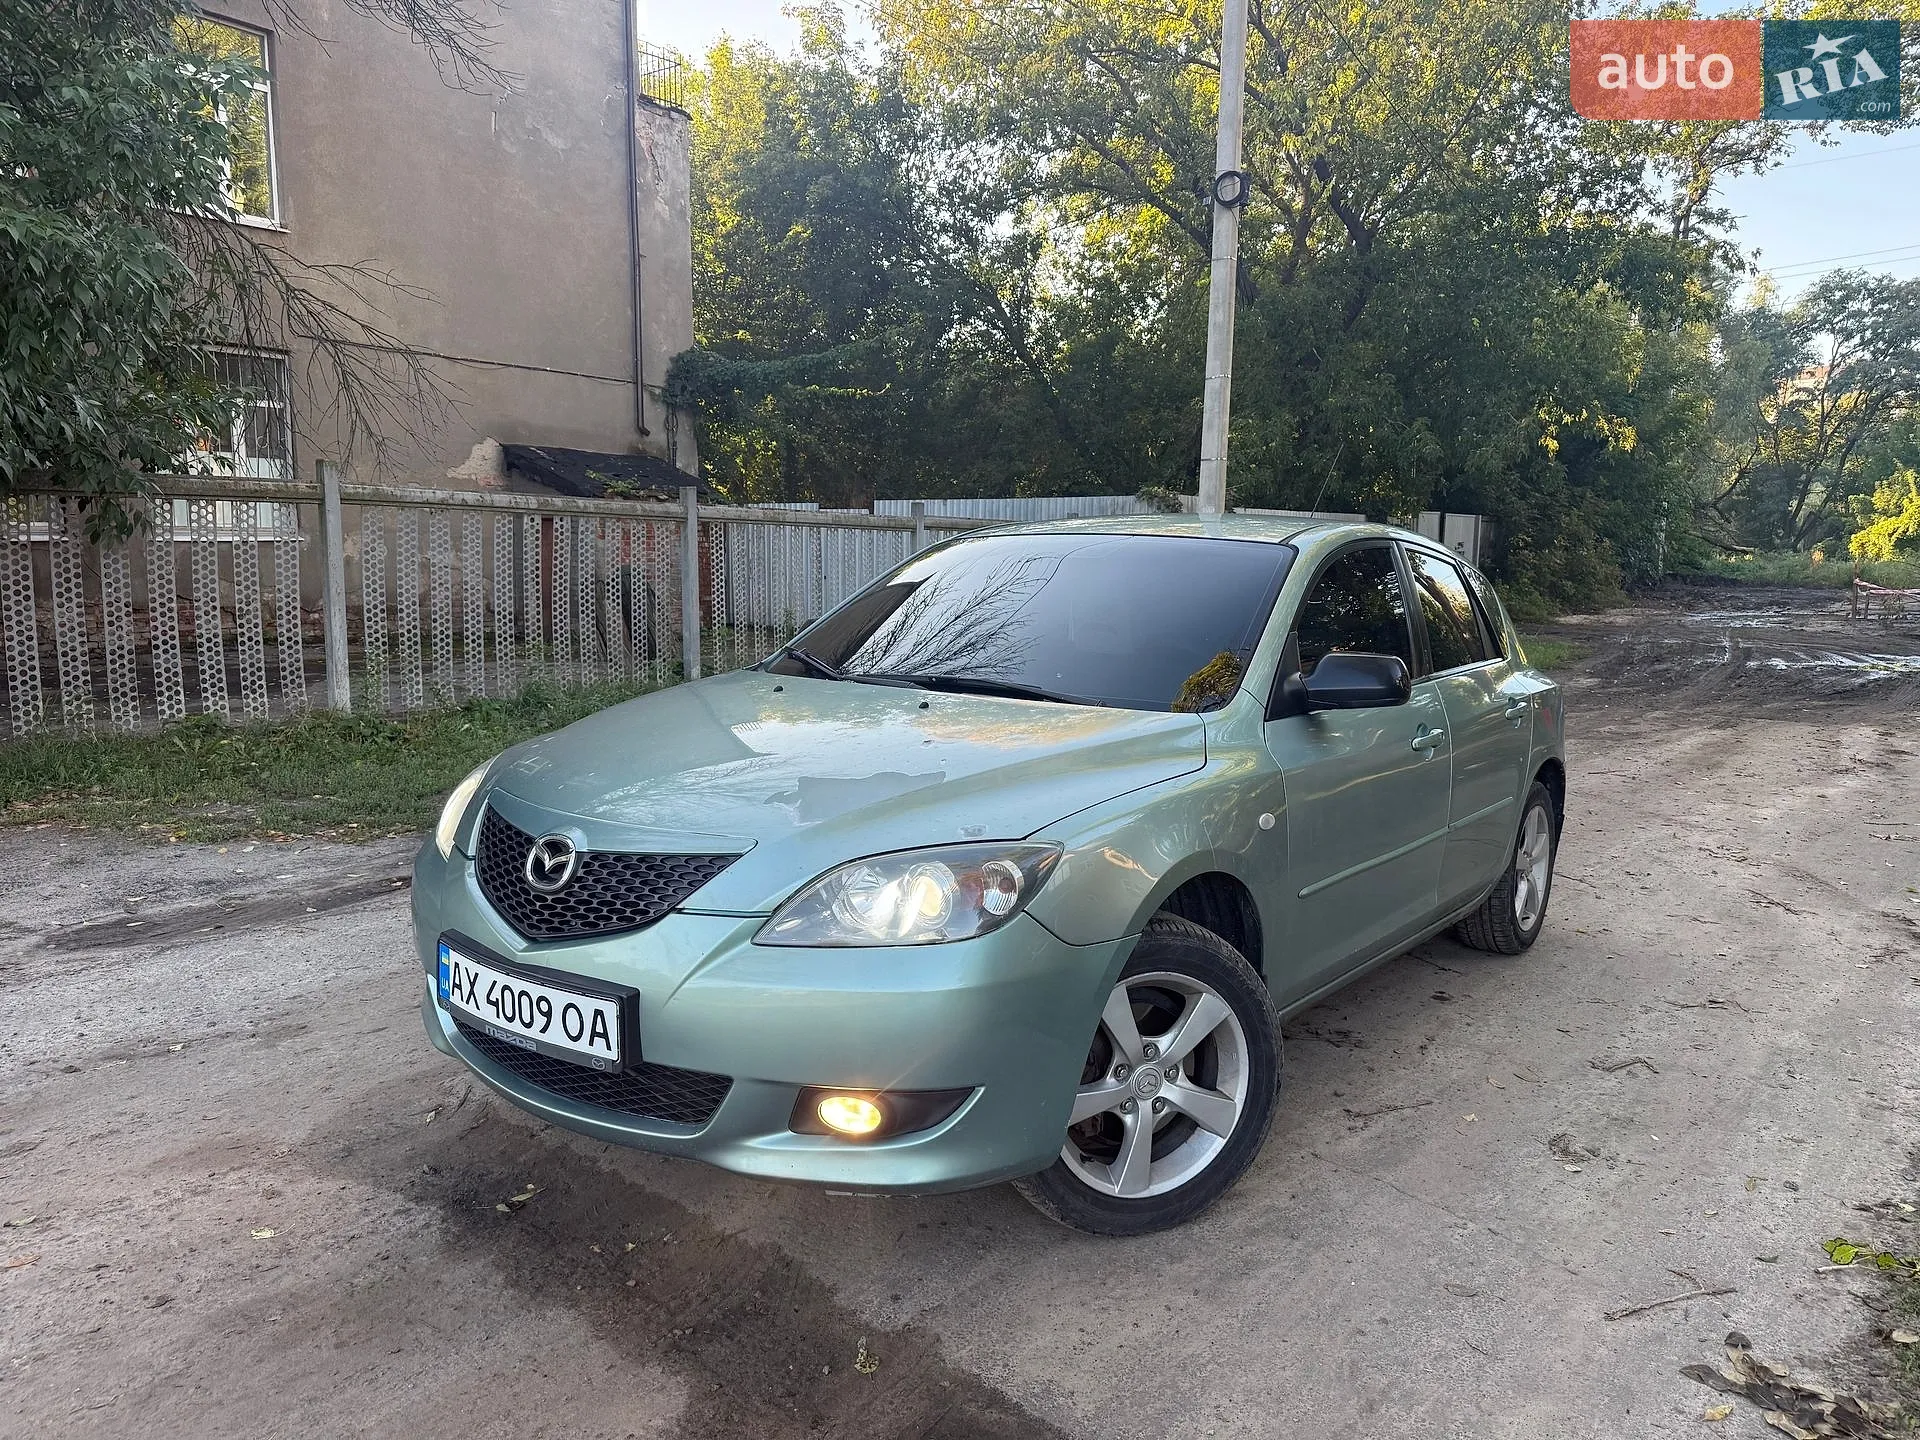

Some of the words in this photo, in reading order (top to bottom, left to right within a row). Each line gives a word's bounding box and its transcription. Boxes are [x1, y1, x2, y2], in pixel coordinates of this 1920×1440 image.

[441, 976, 450, 993] UA
[451, 961, 480, 1011] AX
[486, 980, 553, 1035] 4009
[561, 1002, 612, 1052] OA
